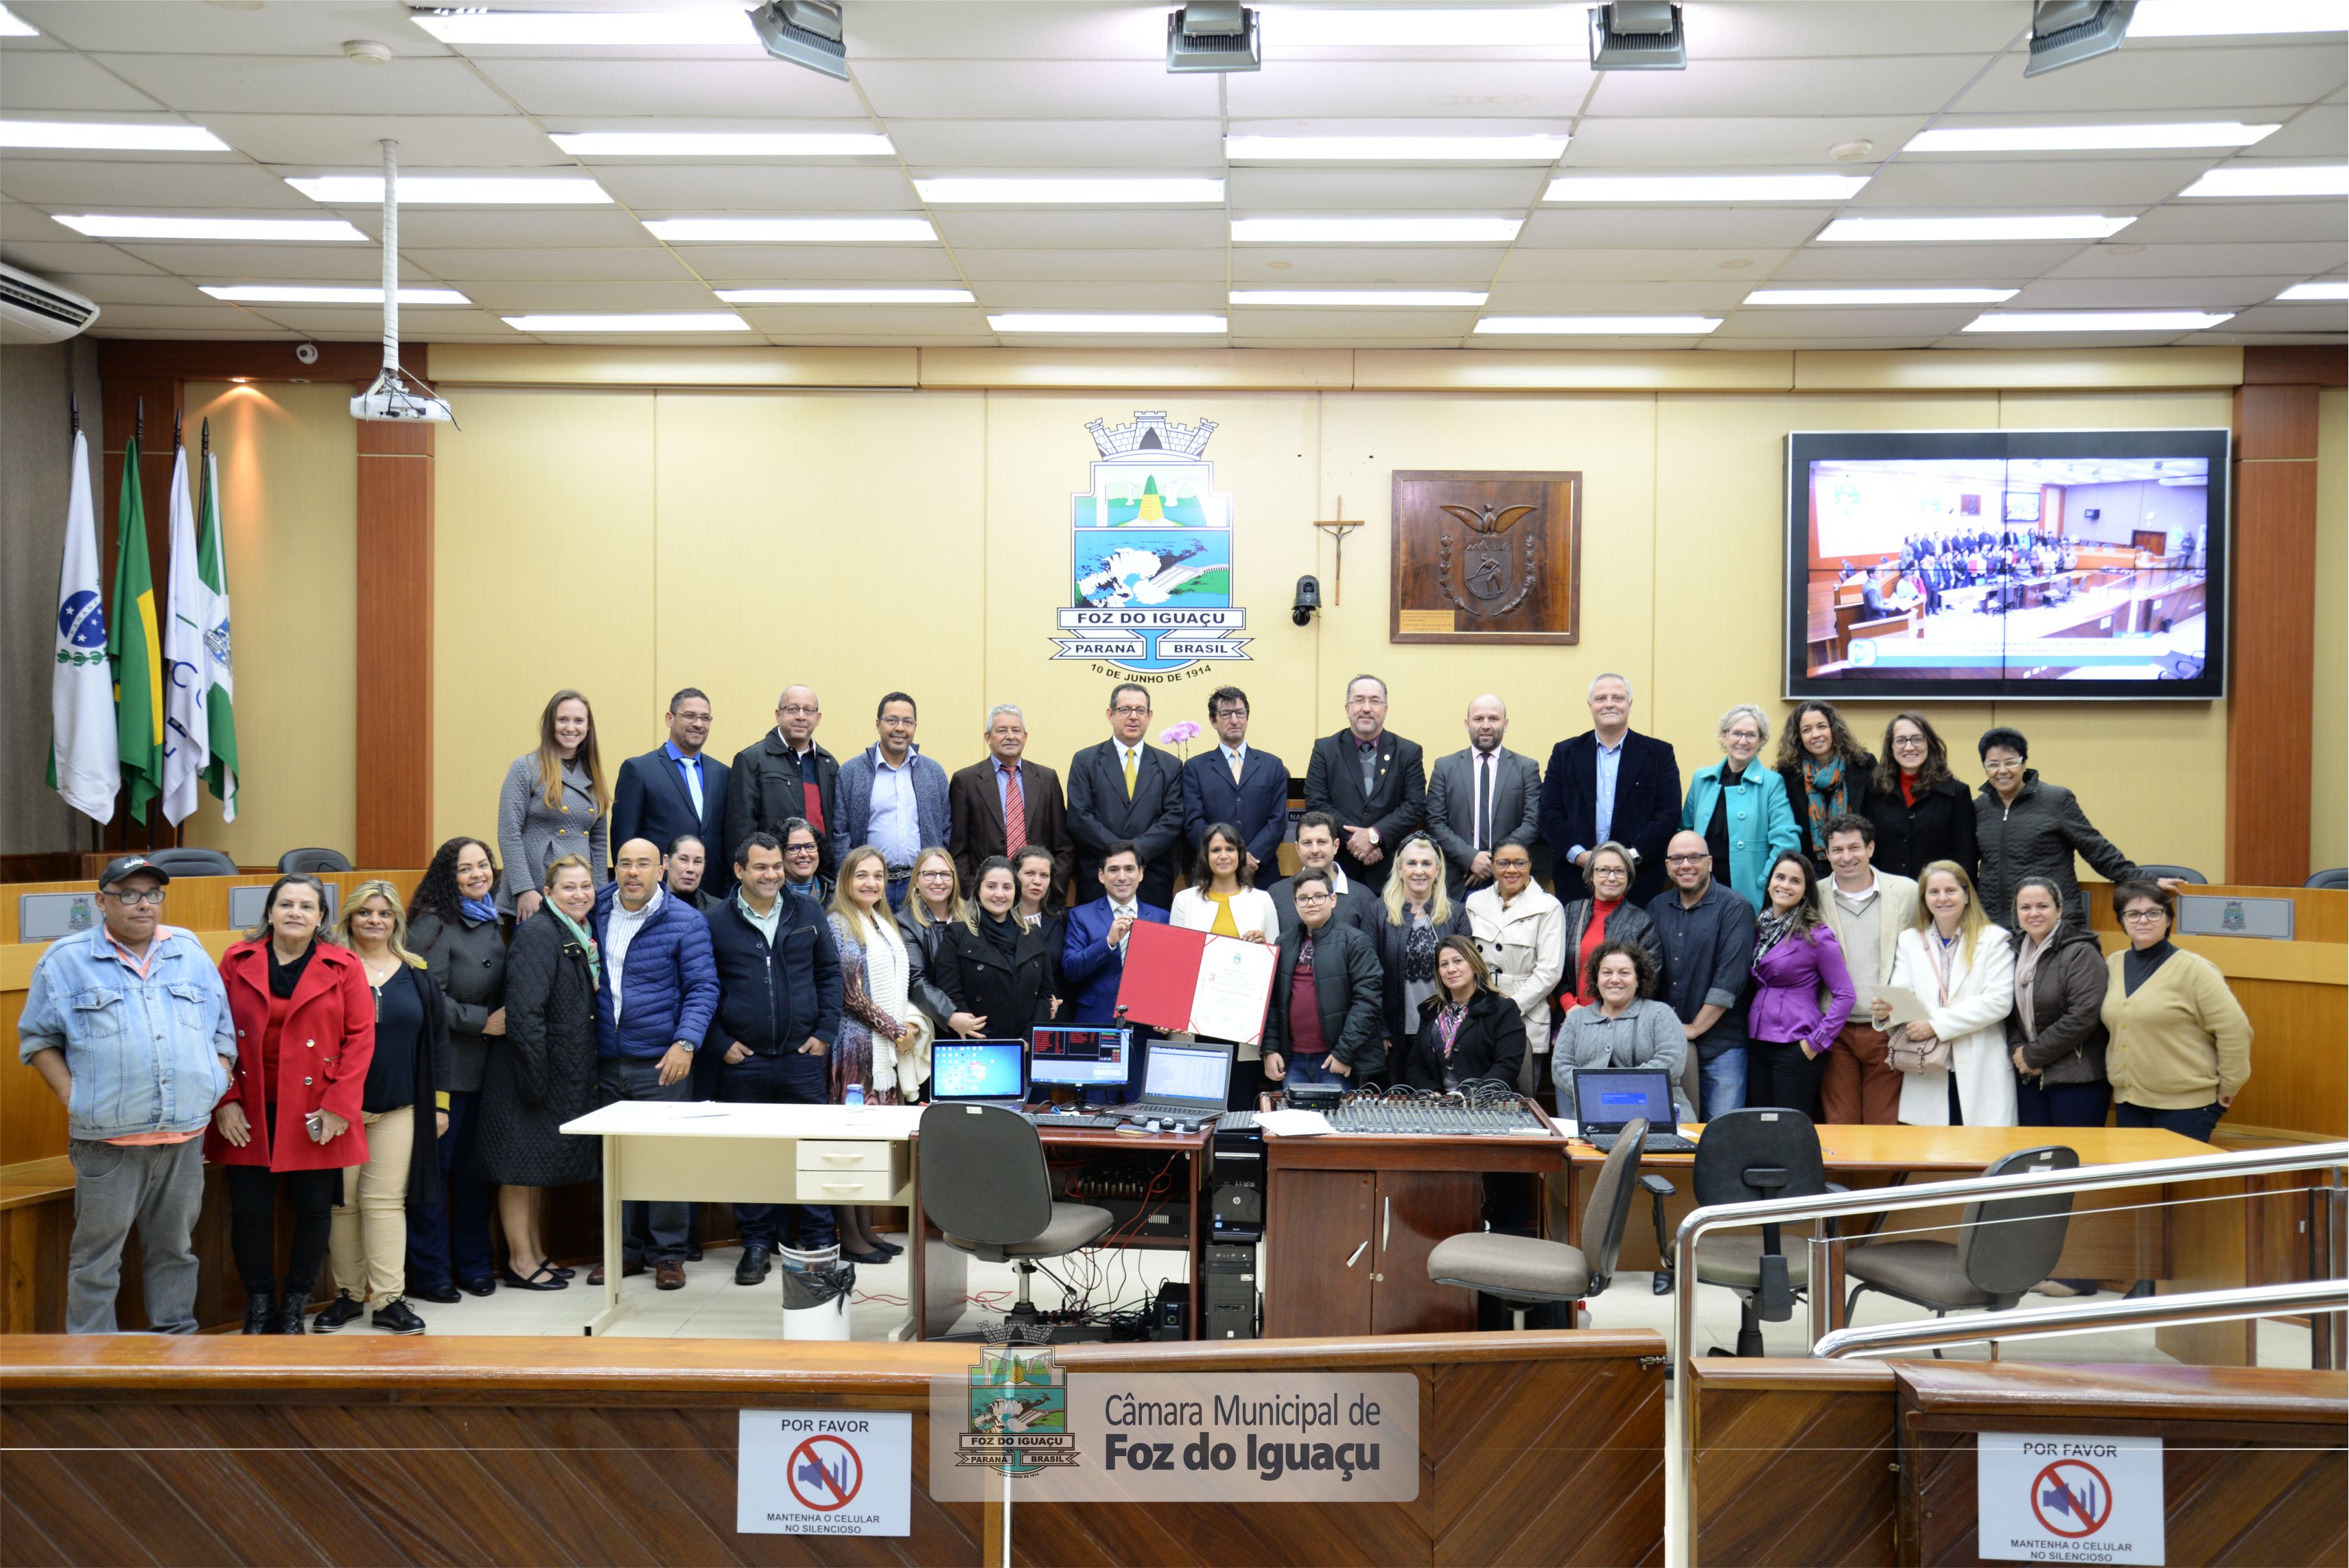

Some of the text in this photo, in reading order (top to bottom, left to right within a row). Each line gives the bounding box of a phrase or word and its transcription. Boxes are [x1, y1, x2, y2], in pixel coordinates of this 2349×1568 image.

[1077, 613, 1225, 627] FOZ DO IGUAÇU
[1075, 642, 1228, 653] PARANÁ BRASIL
[1091, 664, 1211, 683] 10 DE JUNHO DE 1914
[782, 1419, 869, 1433] POR FAVOR
[2023, 1442, 2118, 1458] POR FAVOR
[767, 1513, 880, 1523] MANTENHA O CELULAR
[802, 1525, 861, 1534] SILENCIOSO
[2011, 1539, 2132, 1552] MANTENHA O CELULAR
[2031, 1552, 2112, 1562] NO SILENCIOSO
